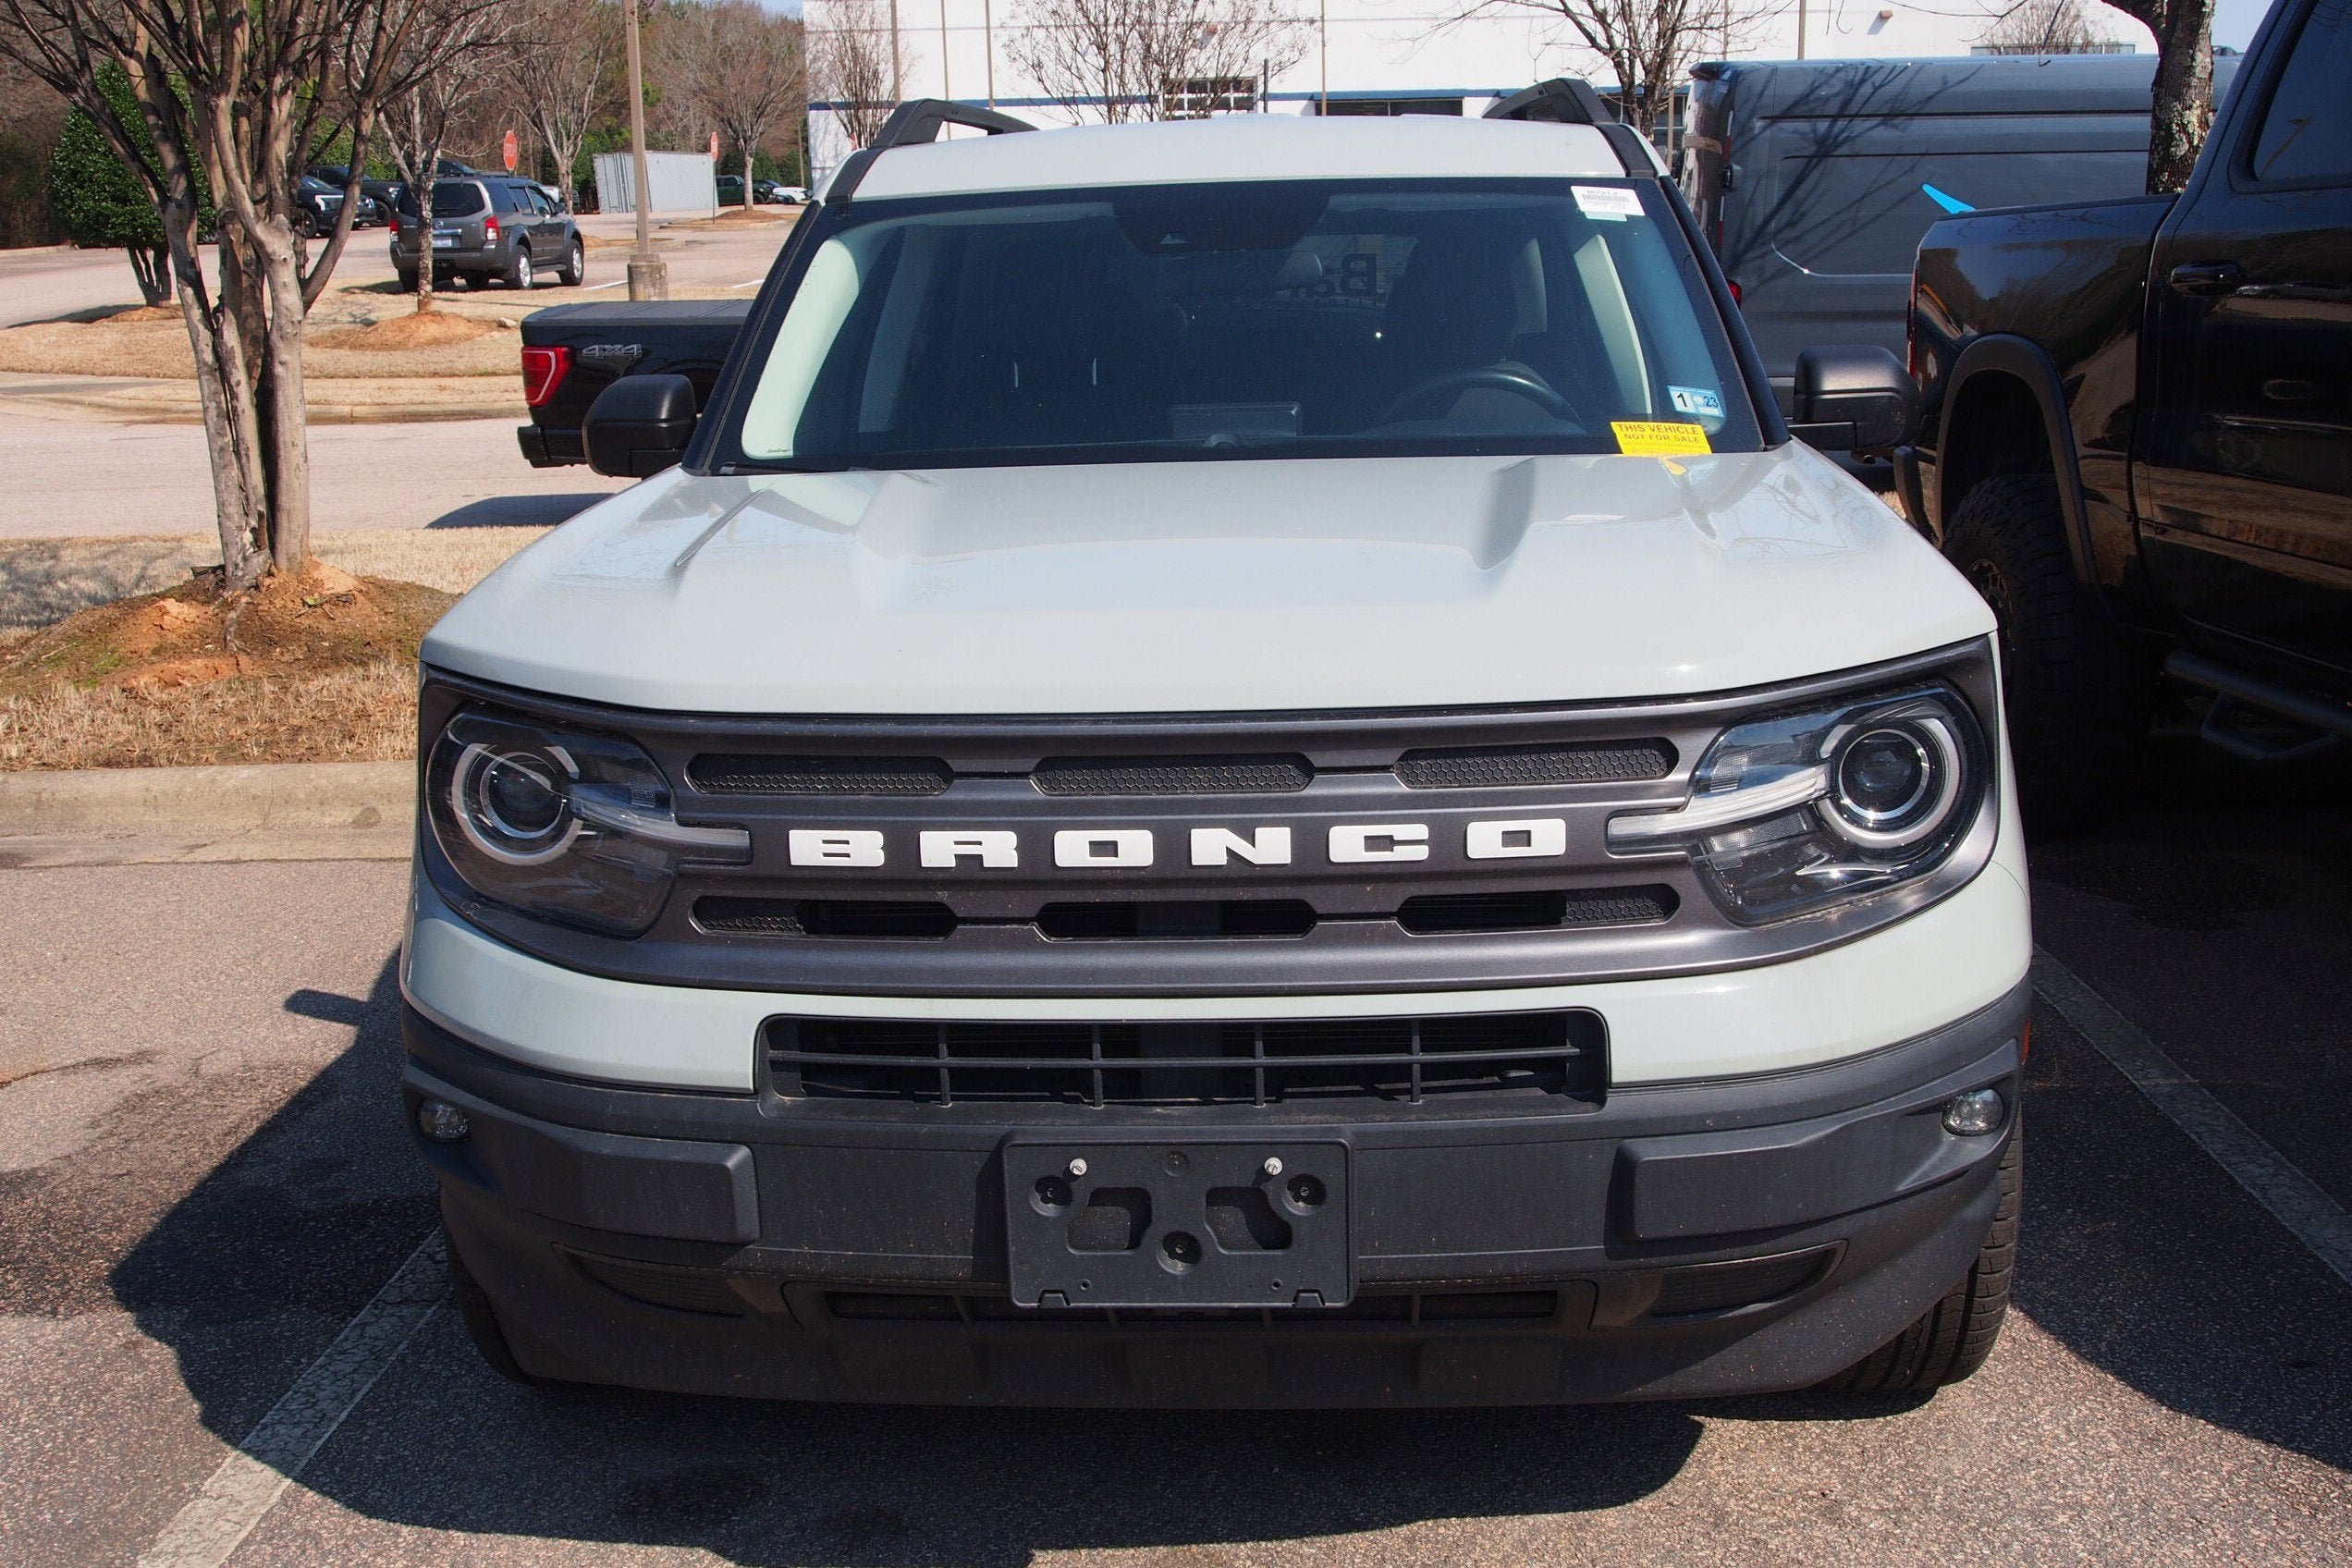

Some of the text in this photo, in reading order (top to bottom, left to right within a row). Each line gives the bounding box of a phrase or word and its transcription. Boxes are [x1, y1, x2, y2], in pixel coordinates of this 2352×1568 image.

[1677, 393, 1719, 408] 1 23
[1618, 423, 1699, 435] THIS VEHICLE
[1674, 435, 1699, 444] SALE
[789, 818, 1566, 868] BRONCO
